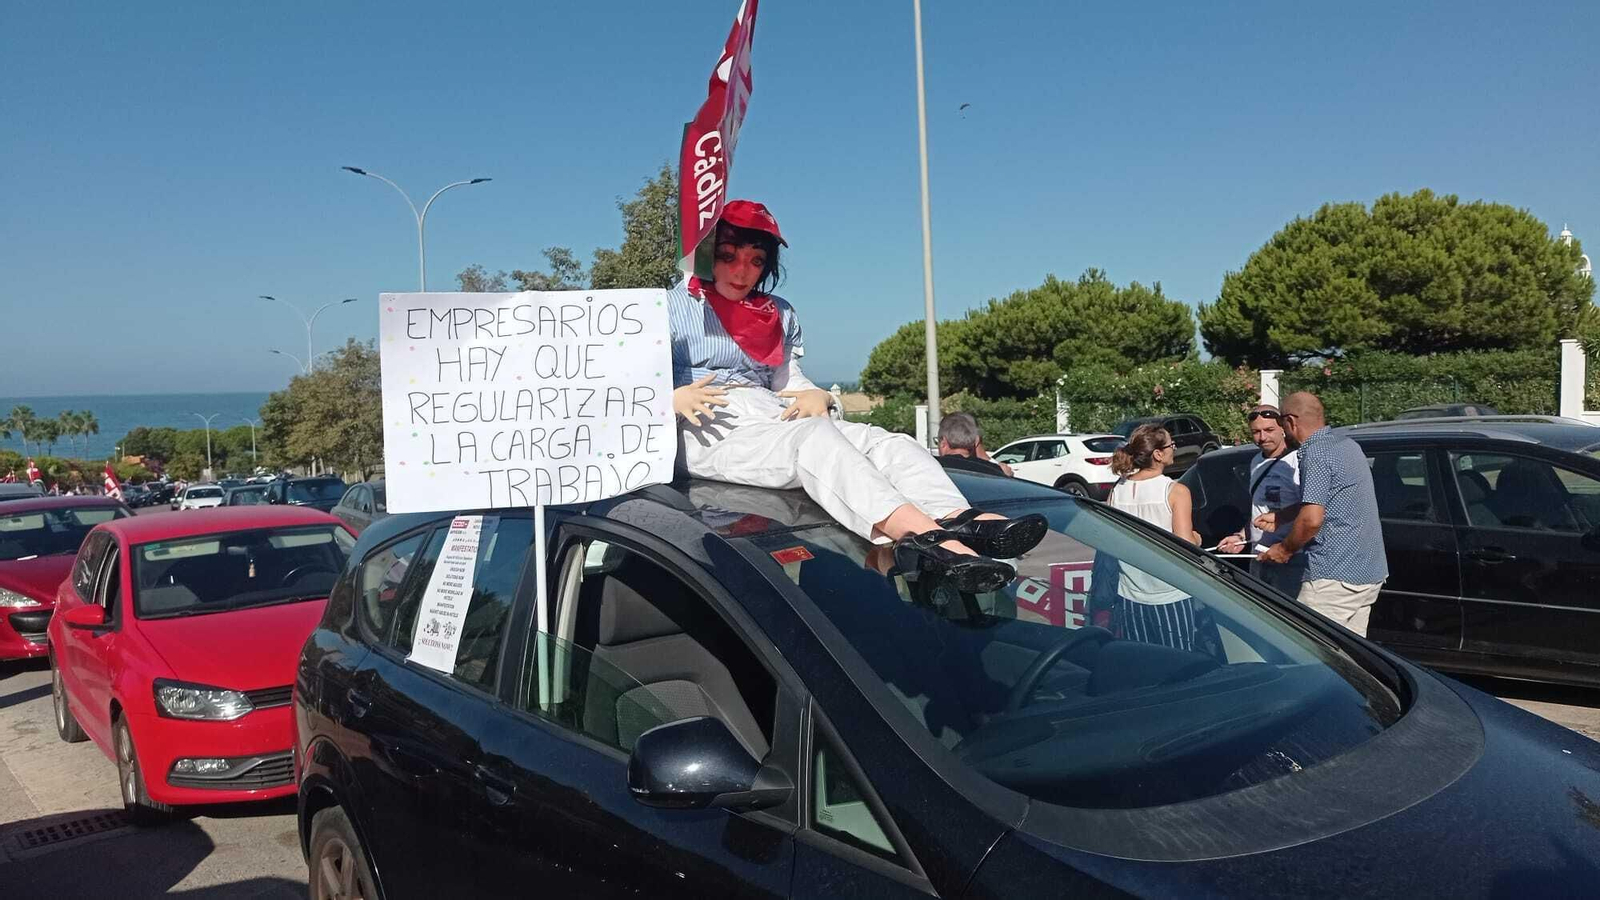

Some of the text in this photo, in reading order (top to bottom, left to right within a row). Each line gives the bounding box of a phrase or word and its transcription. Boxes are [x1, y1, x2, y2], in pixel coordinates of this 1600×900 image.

[437, 344, 605, 382] HAY QUE
[408, 386, 655, 424] REGULARIZAR
[430, 424, 663, 464] LA CARGA DE
